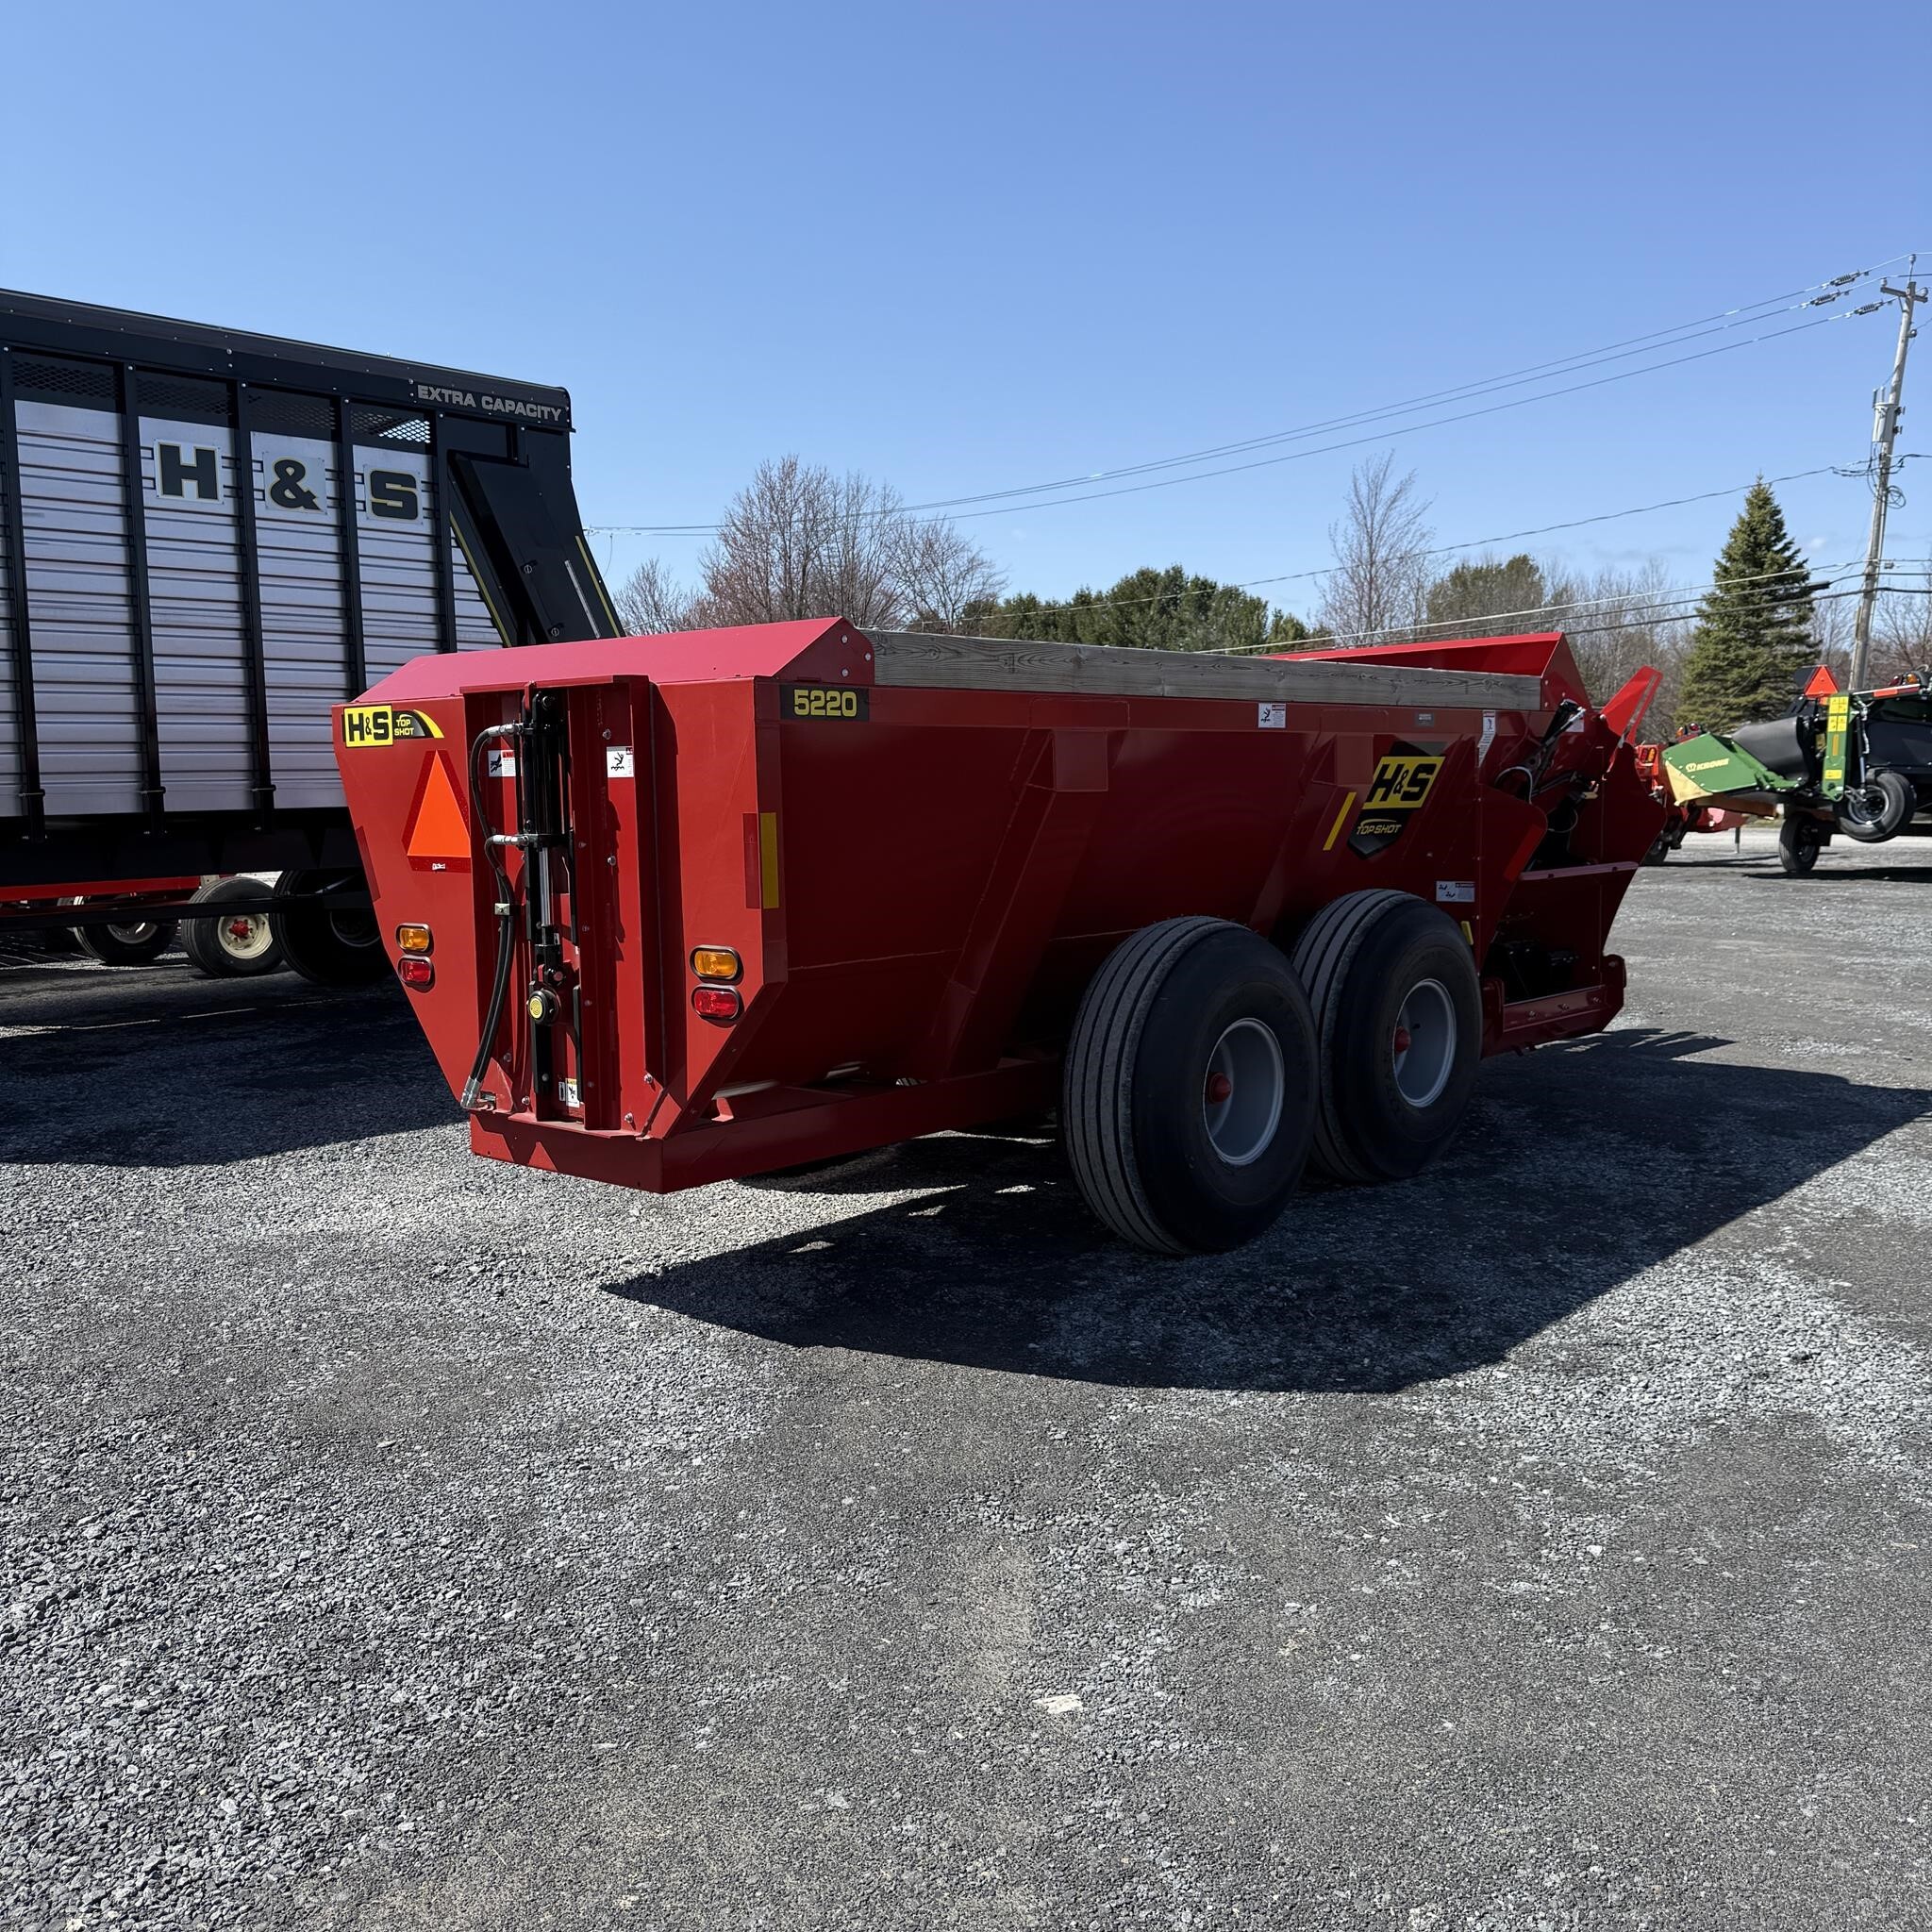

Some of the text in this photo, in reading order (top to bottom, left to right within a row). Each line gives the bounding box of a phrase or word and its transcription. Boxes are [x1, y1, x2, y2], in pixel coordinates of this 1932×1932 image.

[417, 384, 562, 422] EXTRA CAPACITY
[793, 689, 857, 717] 5220
[347, 711, 390, 741] H&S
[394, 727, 414, 736] SHOT
[396, 719, 410, 727] TOP
[1365, 763, 1437, 802] H&S
